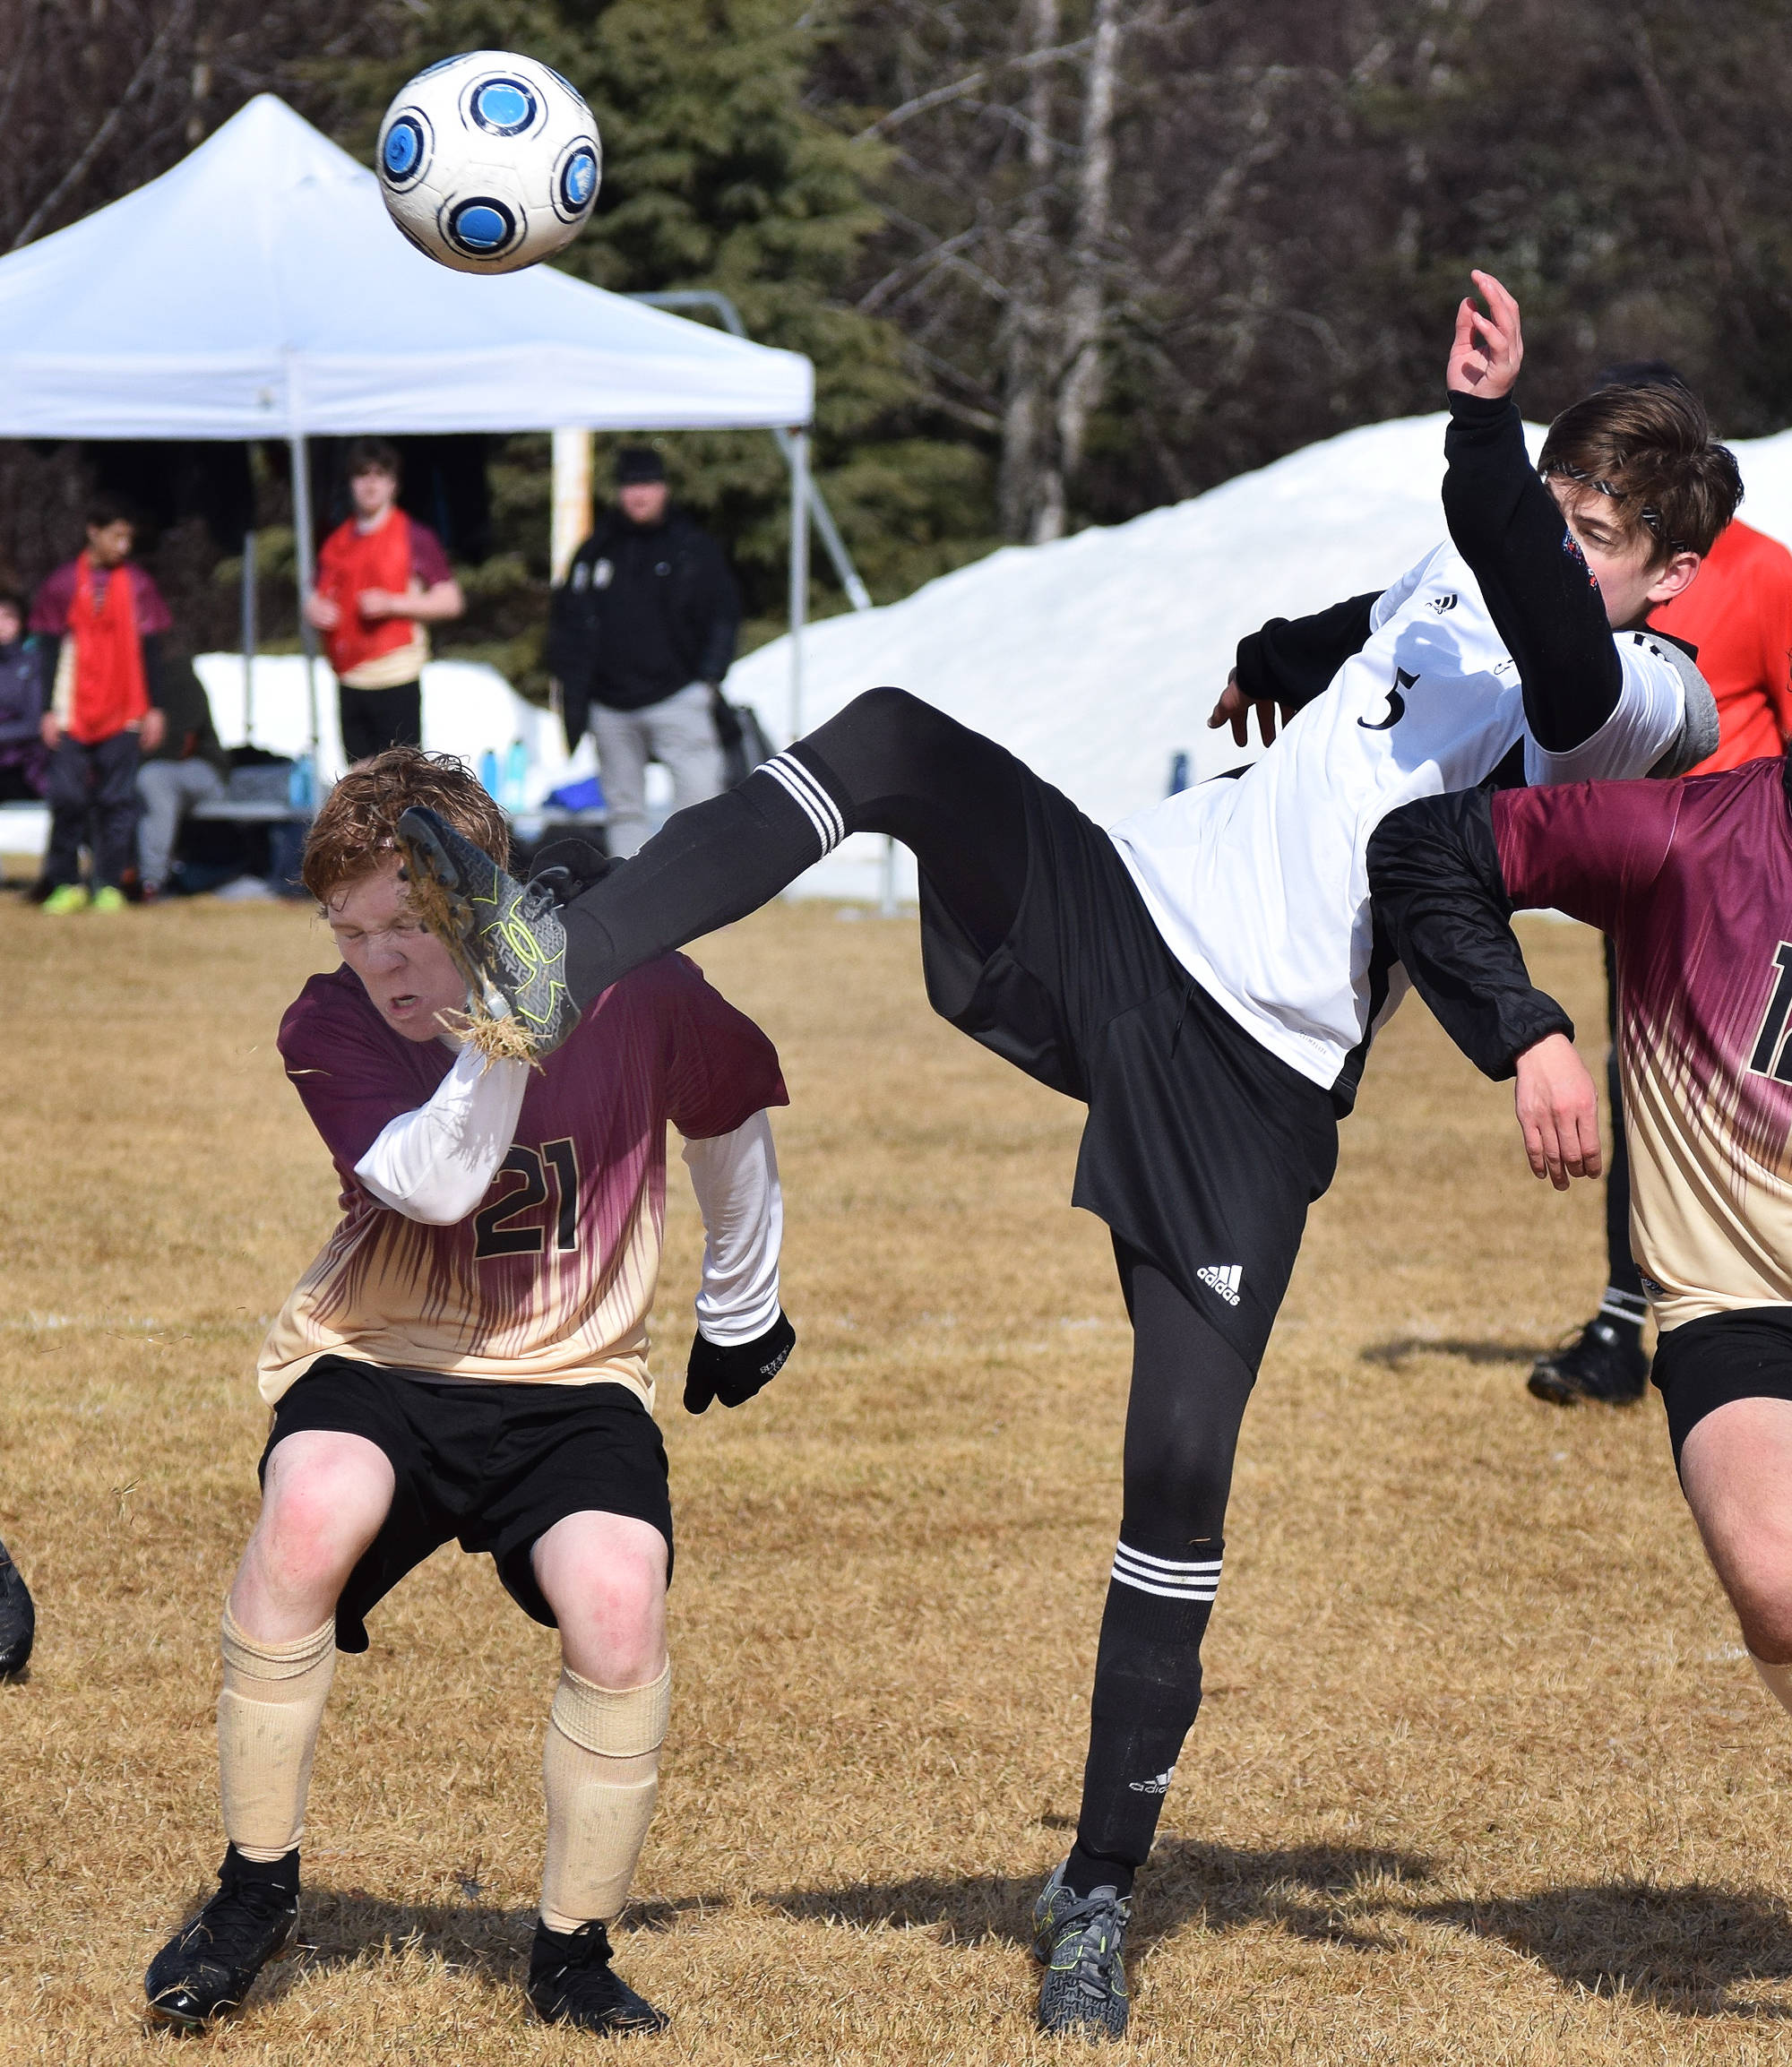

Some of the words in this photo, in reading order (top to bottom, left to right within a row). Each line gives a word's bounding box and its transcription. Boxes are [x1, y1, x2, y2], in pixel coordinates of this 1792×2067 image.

[1357, 666, 1421, 730] 5
[1746, 940, 1792, 1086] 1
[473, 1136, 581, 1260] 21
[1197, 1267, 1241, 1306] adidas
[1129, 1782, 1169, 1794] adid
